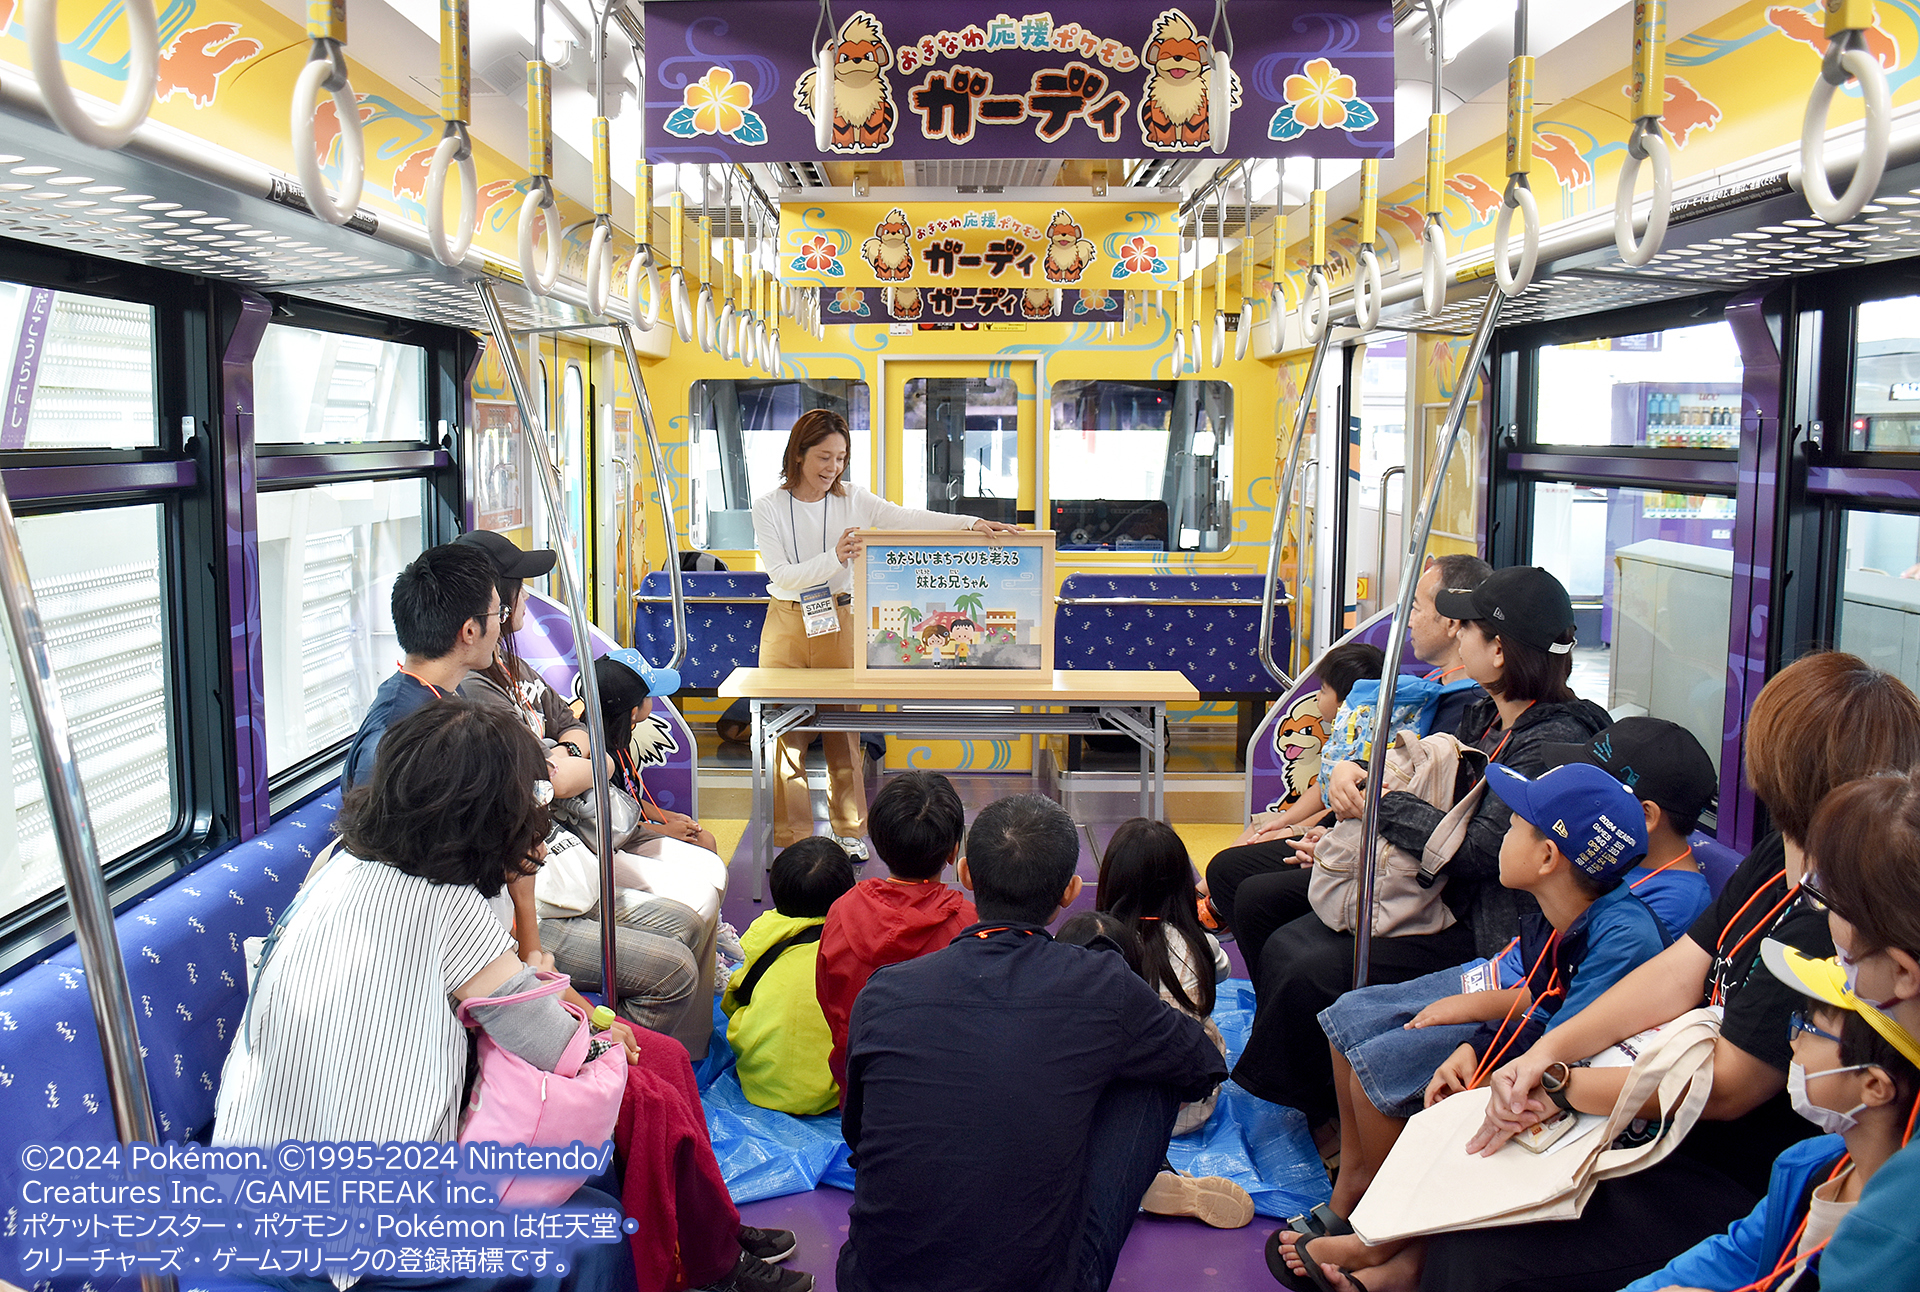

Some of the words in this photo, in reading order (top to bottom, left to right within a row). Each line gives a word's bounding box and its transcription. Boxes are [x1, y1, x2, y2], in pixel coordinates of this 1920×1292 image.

[900, 17, 1136, 71] おきなわ応援ポケモン
[912, 65, 1126, 140] ガーディ
[916, 212, 1043, 240] おきなわ応援ポケモン
[923, 239, 1036, 277] ガーディ
[929, 287, 1016, 315] ガーディ
[11, 289, 49, 428] だこうらにし
[886, 551, 1019, 566] あたらしいまちづくりを考える
[916, 575, 989, 589] 妹とお兄ちゃん
[806, 600, 831, 612] STAFF
[1599, 814, 1617, 832] 2024
